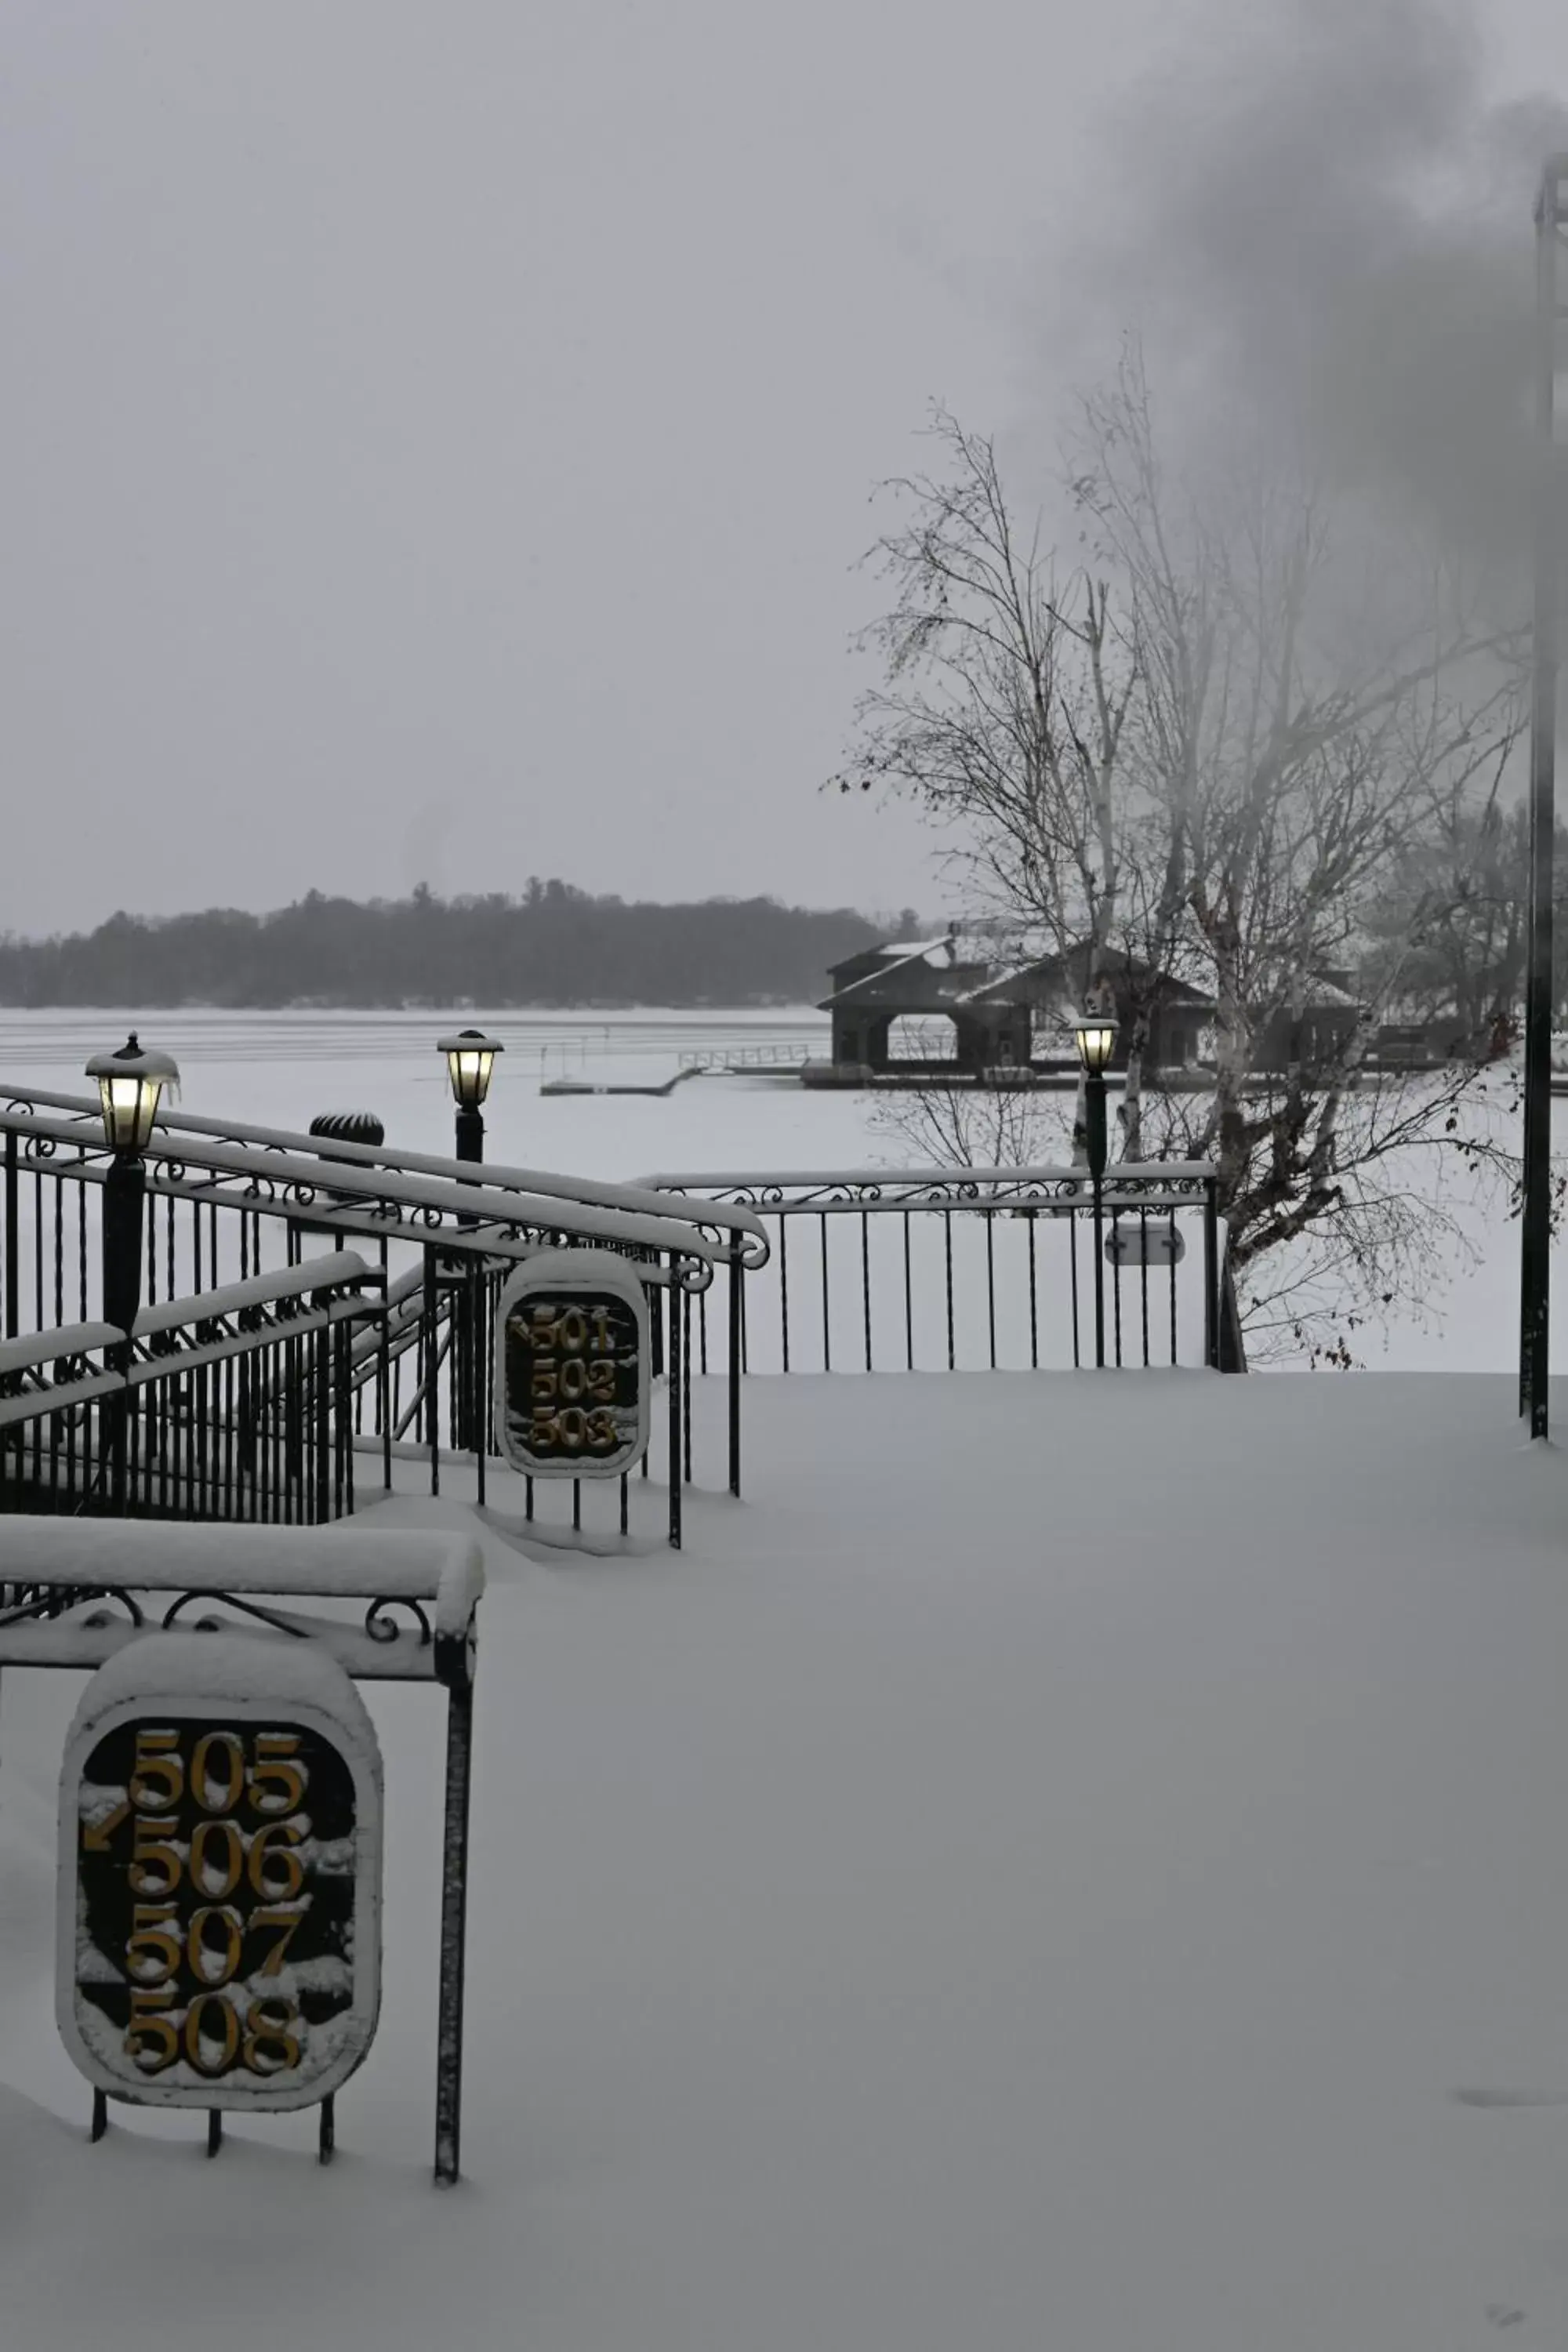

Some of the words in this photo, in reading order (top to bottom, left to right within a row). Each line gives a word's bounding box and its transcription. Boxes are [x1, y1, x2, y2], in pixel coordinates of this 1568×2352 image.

[531, 1305, 614, 1350] 501
[531, 1358, 615, 1399] 502
[528, 1406, 615, 1446] 503
[129, 1730, 307, 1816] 505
[128, 1817, 306, 1900] 506
[126, 1903, 304, 1984] 507
[123, 1986, 301, 2072] 508
